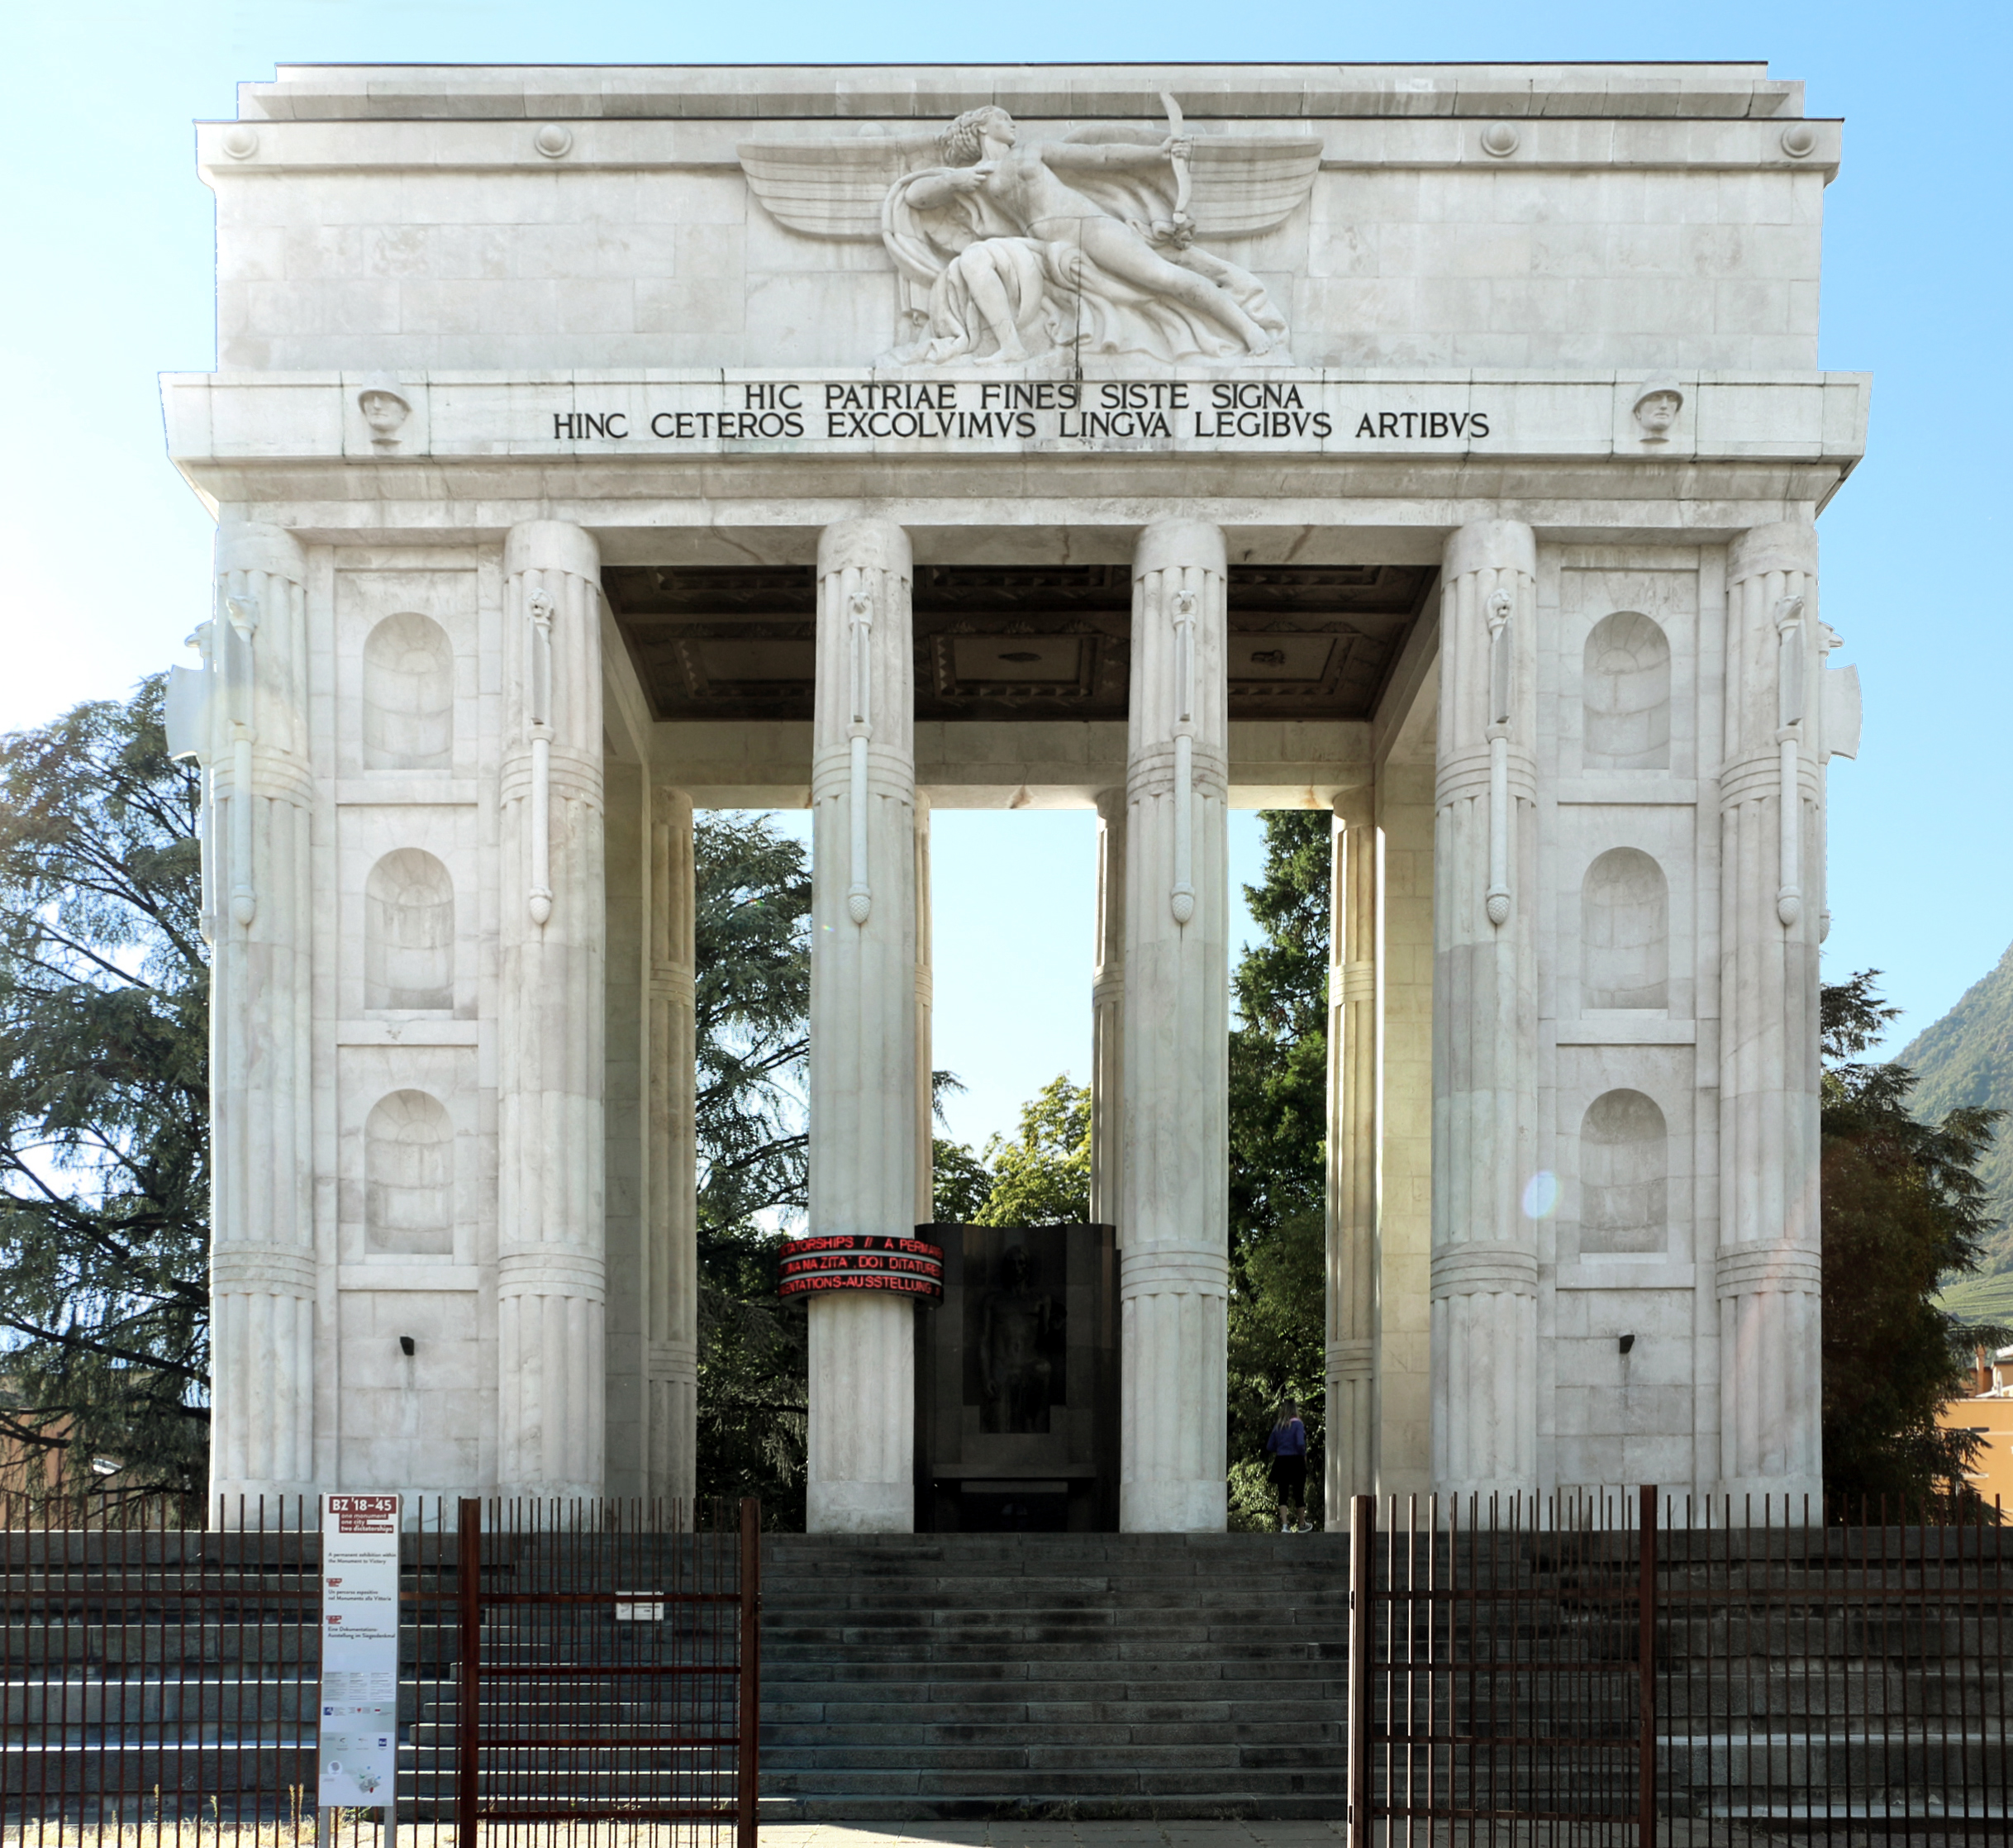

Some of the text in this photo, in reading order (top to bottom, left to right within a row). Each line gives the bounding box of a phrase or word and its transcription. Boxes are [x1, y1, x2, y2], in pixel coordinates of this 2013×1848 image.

[745, 383, 1304, 410] HIC PATRIAE FINES SISTE SIGNA
[554, 412, 1489, 439] HINC CETEROS EXCOLVIMVS LINGVA LEGIBVS ARTIBVS
[884, 1237, 894, 1249] A
[859, 1255, 883, 1268] DOI
[332, 1499, 349, 1511] BZ
[354, 1518, 365, 1527] city
[354, 1524, 393, 1533] dictatorships
